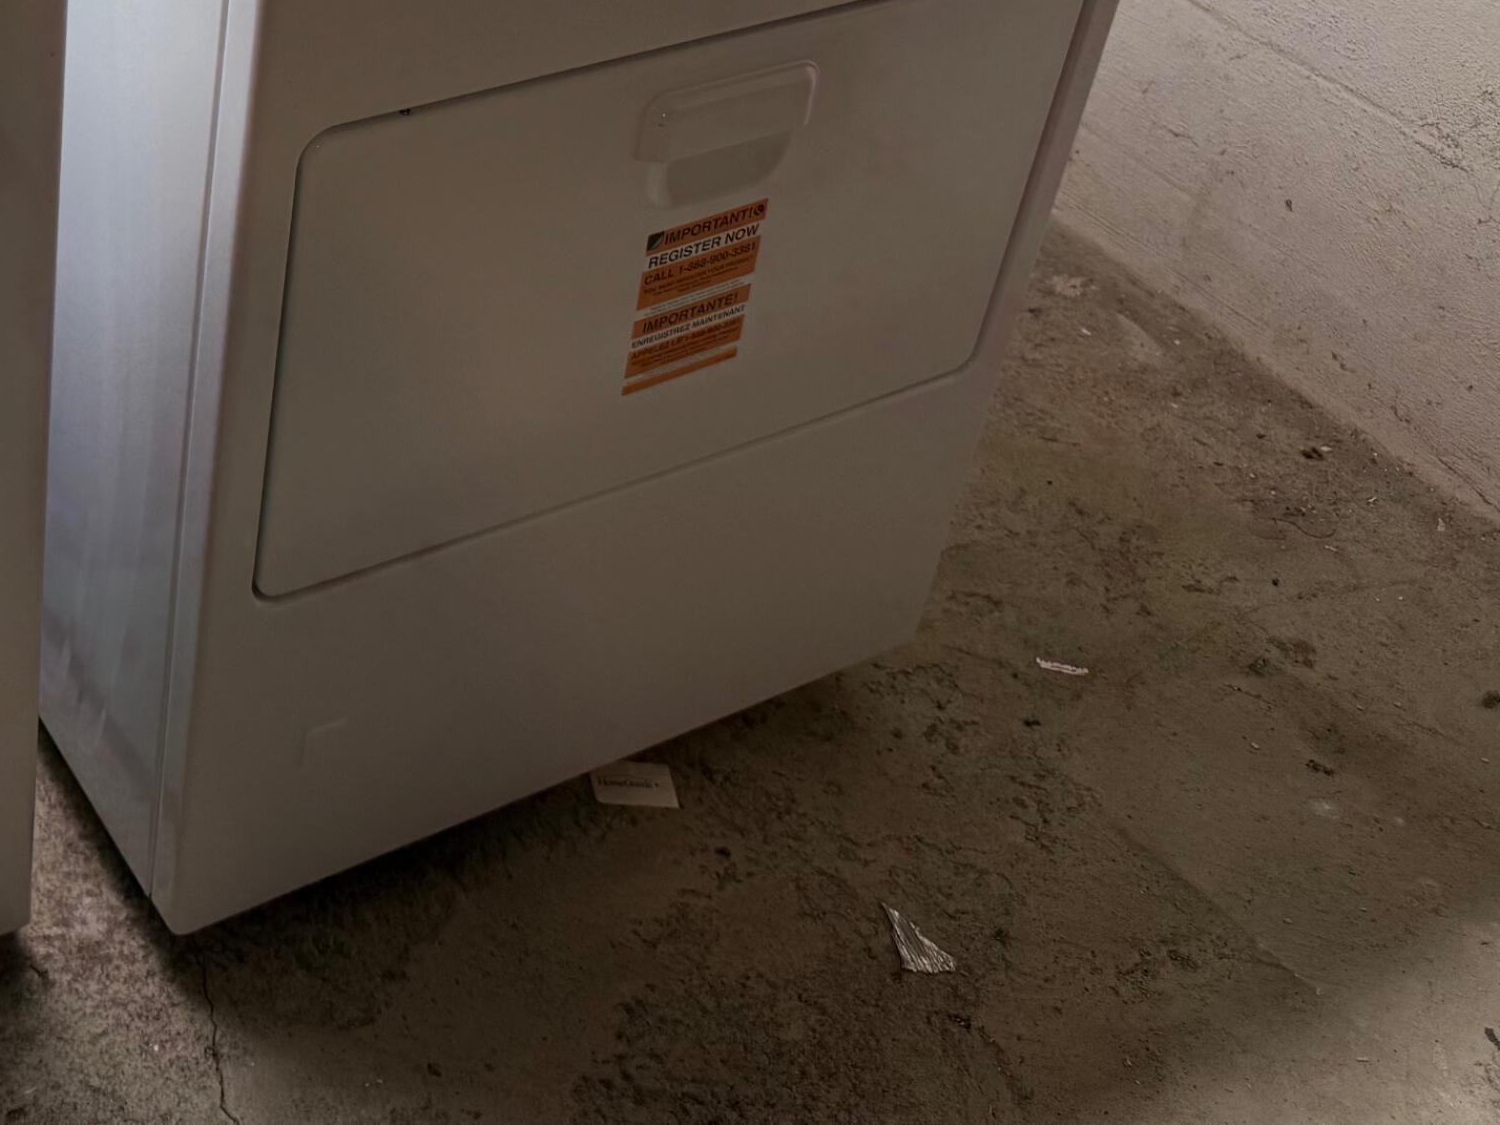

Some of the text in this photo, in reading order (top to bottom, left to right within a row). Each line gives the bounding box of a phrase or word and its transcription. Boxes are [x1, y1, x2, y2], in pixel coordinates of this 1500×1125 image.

[648, 223, 760, 269] REGISTER NOW
[643, 268, 674, 286] CALL
[631, 324, 690, 348] ENREGISTREZ
[691, 304, 746, 327] MAINTENANT
[643, 292, 739, 333] IMPORTANTE!
